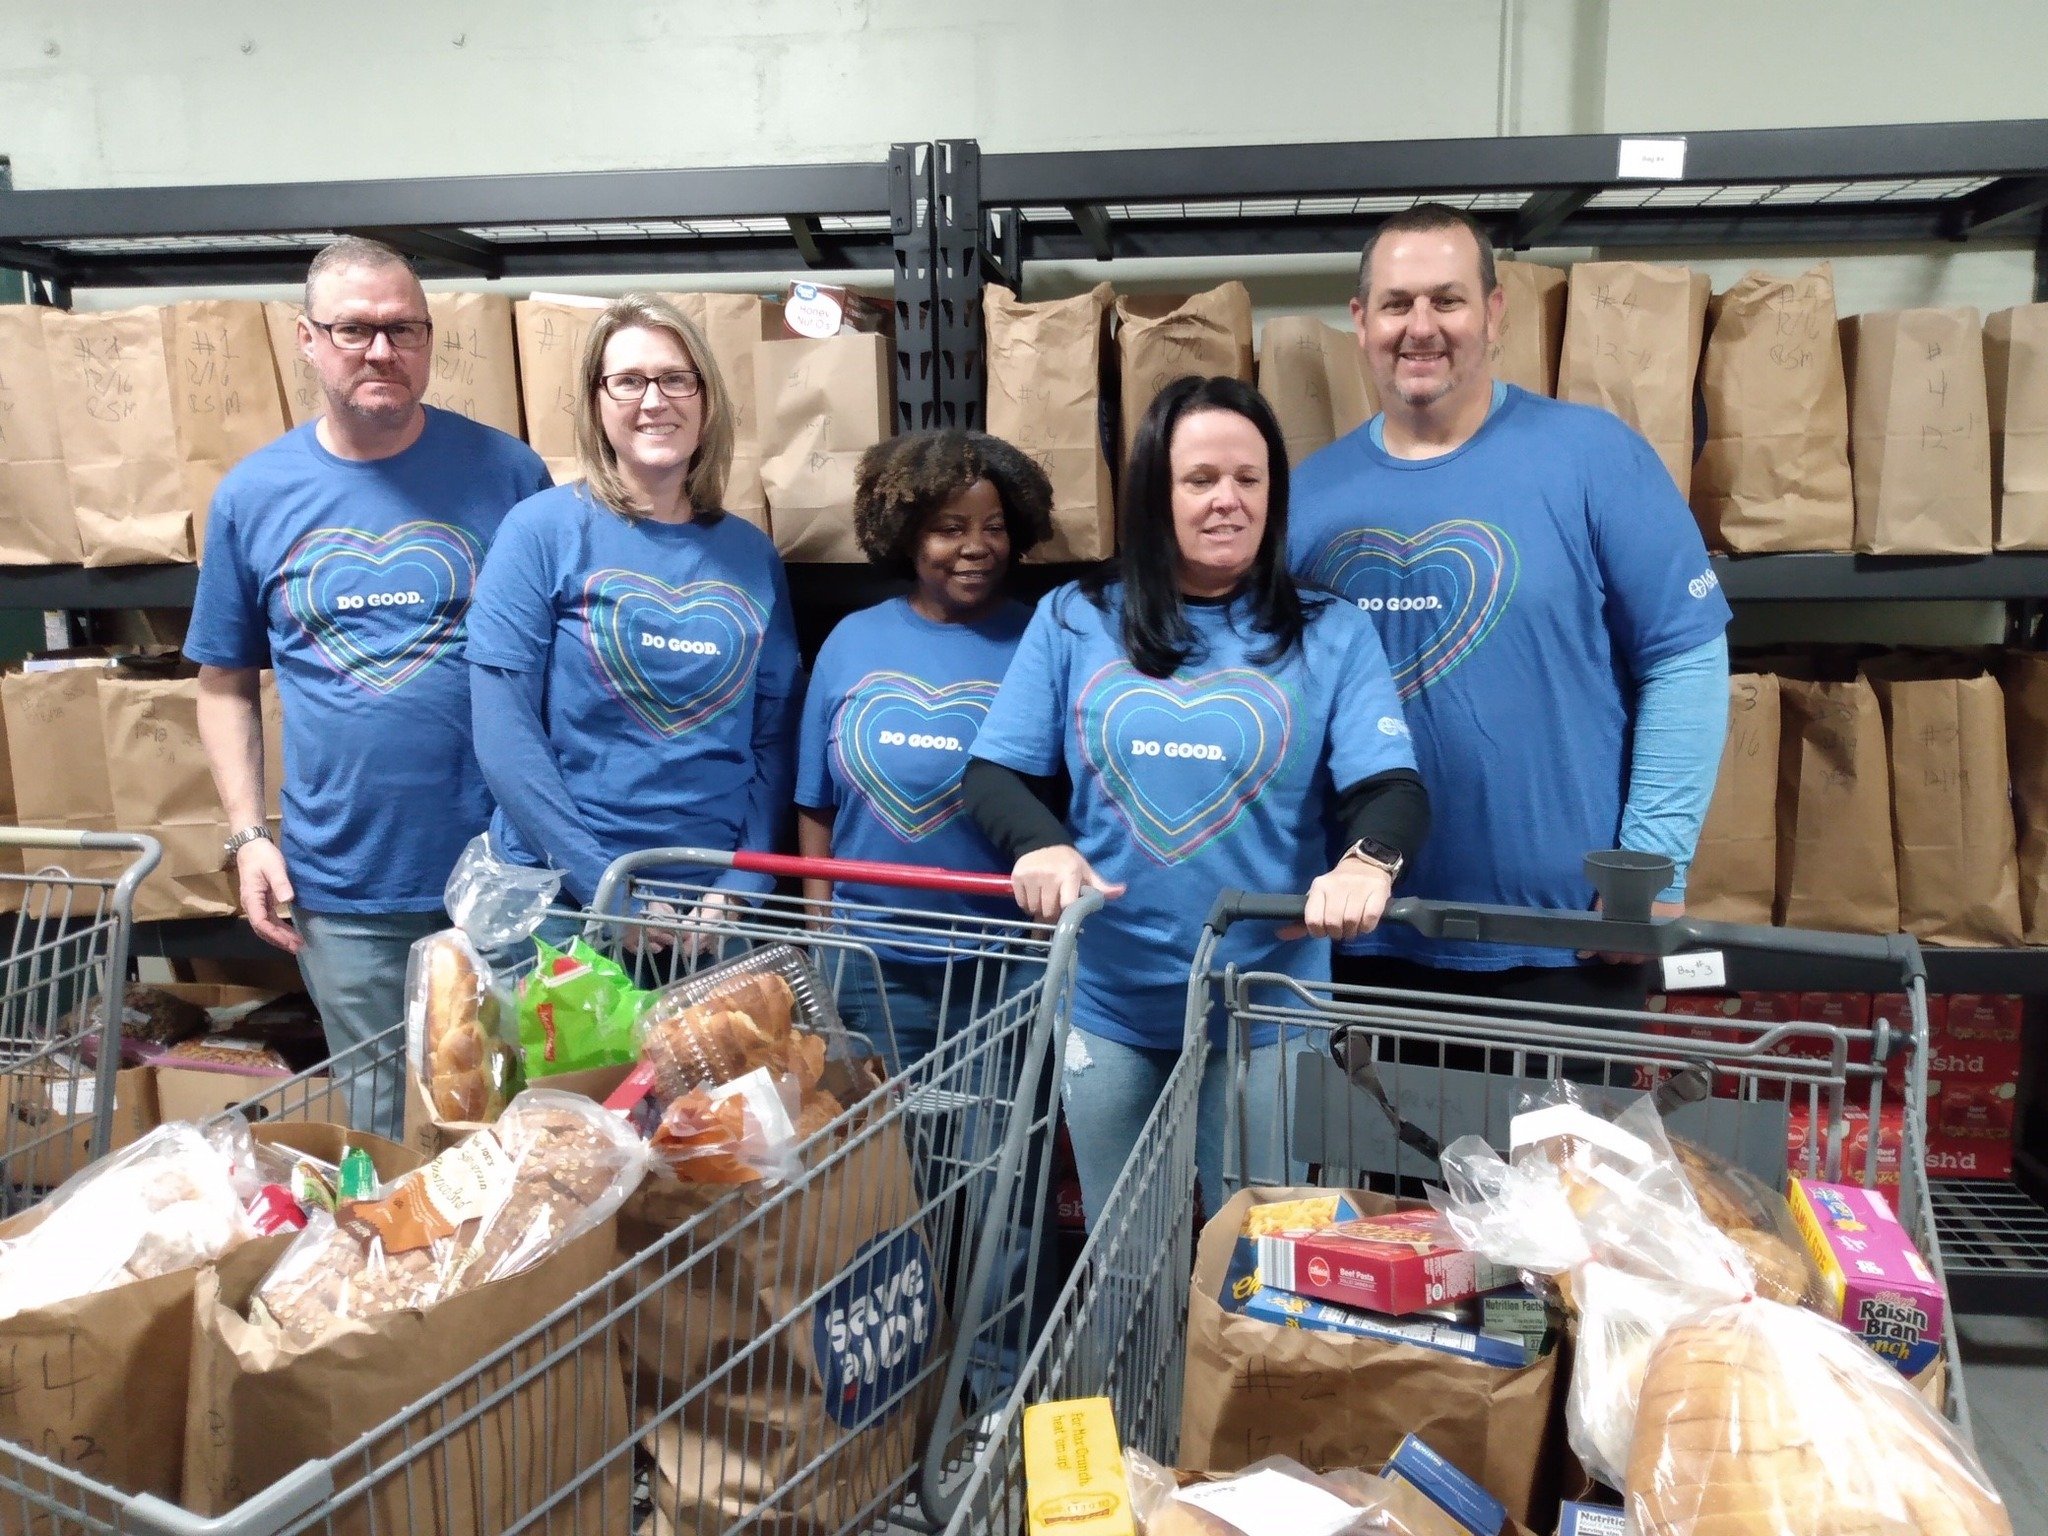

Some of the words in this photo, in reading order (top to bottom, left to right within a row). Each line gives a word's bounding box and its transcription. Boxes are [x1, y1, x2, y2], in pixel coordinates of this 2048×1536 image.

[799, 304, 830, 318] Honey
[797, 315, 813, 326] Nut
[337, 595, 364, 609] DO
[367, 591, 424, 606] GOOD.
[1357, 598, 1384, 611] DO
[1386, 596, 1442, 611] GOOD.
[641, 632, 665, 649] DO
[668, 638, 721, 655] GOOD.
[879, 731, 905, 746] DO
[908, 734, 963, 752] GOOD.
[1131, 740, 1160, 756] DO
[1164, 742, 1226, 761] GOOD.
[1927, 1054, 1984, 1072] sh'd
[1926, 1151, 1976, 1170] sh'd
[1339, 1267, 1355, 1278] Beef
[1356, 1270, 1375, 1282] Pasta
[825, 1258, 925, 1354] save
[1485, 1299, 1519, 1311] Nutrition
[1522, 1300, 1543, 1311] Facts
[1859, 1299, 1928, 1331] Raisin
[1865, 1317, 1919, 1345] Bran
[1073, 1428, 1087, 1446] Max
[1580, 1511, 1626, 1527] Nutritio
